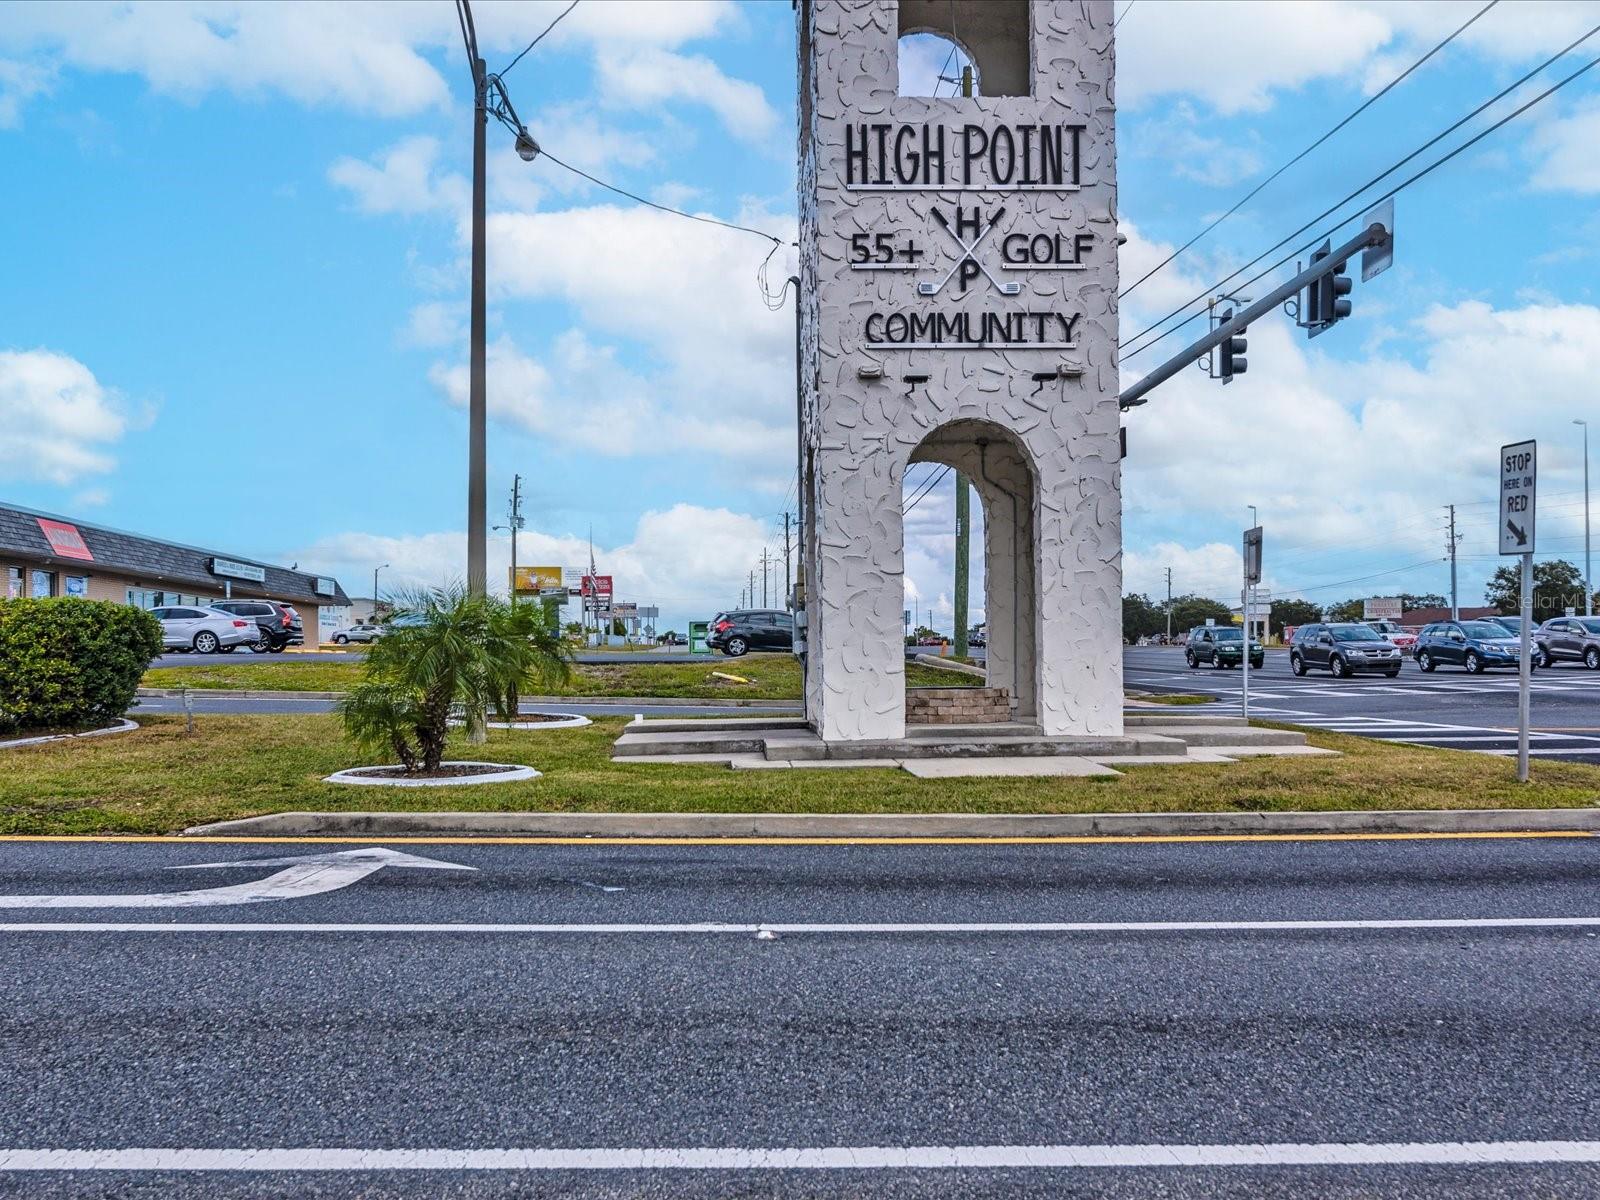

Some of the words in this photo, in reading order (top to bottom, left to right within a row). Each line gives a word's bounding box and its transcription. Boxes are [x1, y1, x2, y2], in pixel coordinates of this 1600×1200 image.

[846, 124, 944, 185] HIGH
[963, 124, 1087, 185] POINT
[851, 233, 923, 264] 55+
[1002, 233, 1094, 264] GOLF
[865, 312, 1081, 343] COMMUNITY
[1505, 452, 1532, 473] STOP
[1504, 477, 1520, 490] HERE
[1523, 476, 1533, 488] ON
[1507, 494, 1528, 513] RED
